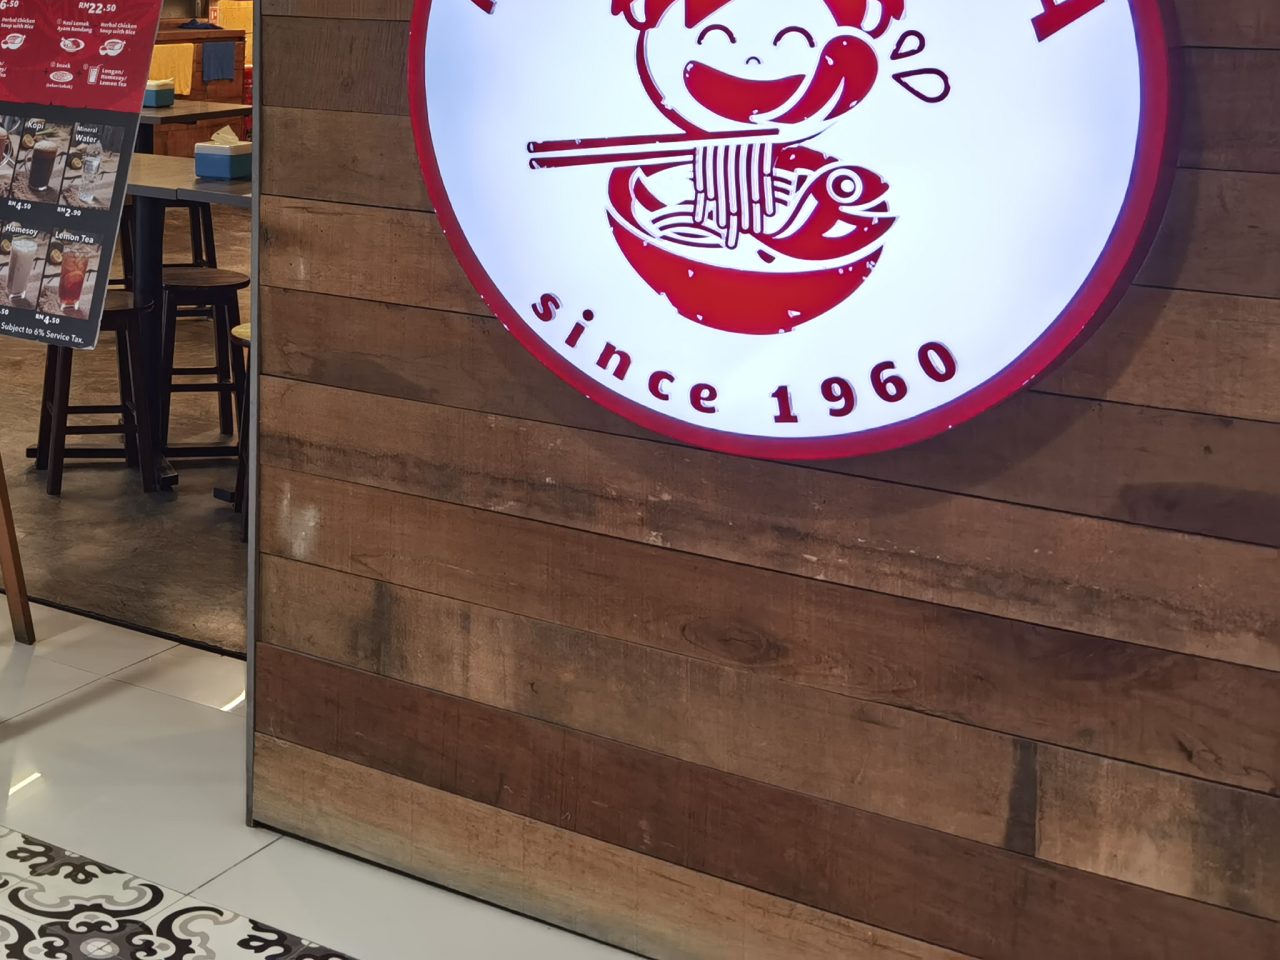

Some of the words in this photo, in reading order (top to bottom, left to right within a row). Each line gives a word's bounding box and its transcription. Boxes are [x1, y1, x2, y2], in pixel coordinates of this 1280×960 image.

[78, 2, 117, 14] RM22.50
[27, 120, 45, 131] Kopi
[76, 125, 99, 134] Mineral
[75, 134, 97, 143] Water
[7, 200, 32, 211] RM4.50
[56, 206, 82, 217] RM2.90
[5, 224, 39, 237] Homesoy
[55, 231, 80, 242] Lemon
[81, 235, 94, 244] Tea
[35, 313, 60, 324] RM4.50
[1, 321, 25, 334] Subject
[25, 326, 33, 334] to
[33, 327, 45, 337] 6%
[45, 330, 70, 341] Service
[71, 334, 84, 344] Tax.
[530, 291, 719, 415] since
[770, 341, 960, 424] 1960
